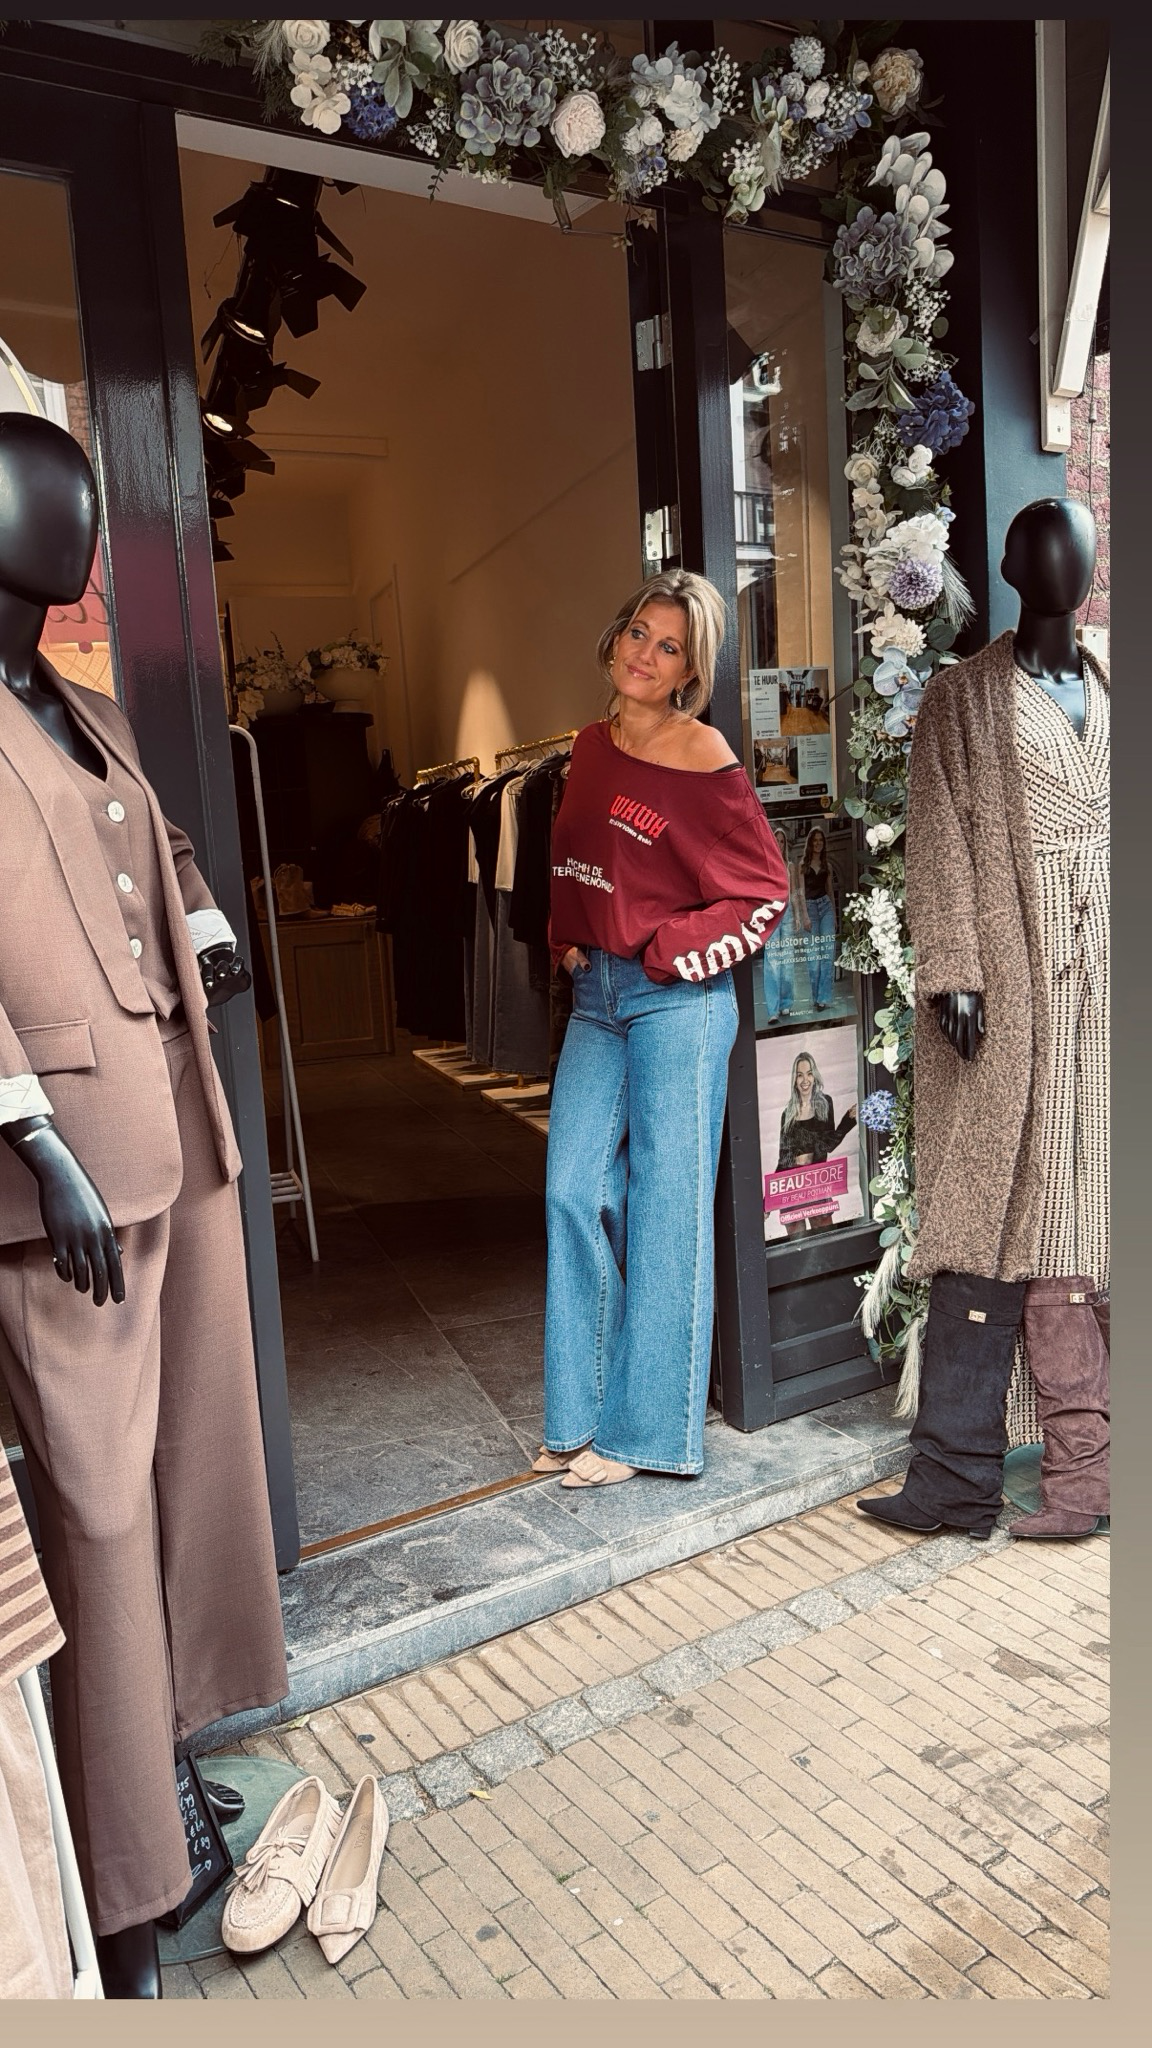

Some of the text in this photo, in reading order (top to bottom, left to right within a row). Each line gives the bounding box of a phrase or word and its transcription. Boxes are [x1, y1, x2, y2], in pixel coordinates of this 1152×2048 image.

[754, 674, 778, 686] TE HUUR
[764, 934, 836, 950] BeauStore Jeans
[769, 1165, 843, 1195] BEAUSTORE
